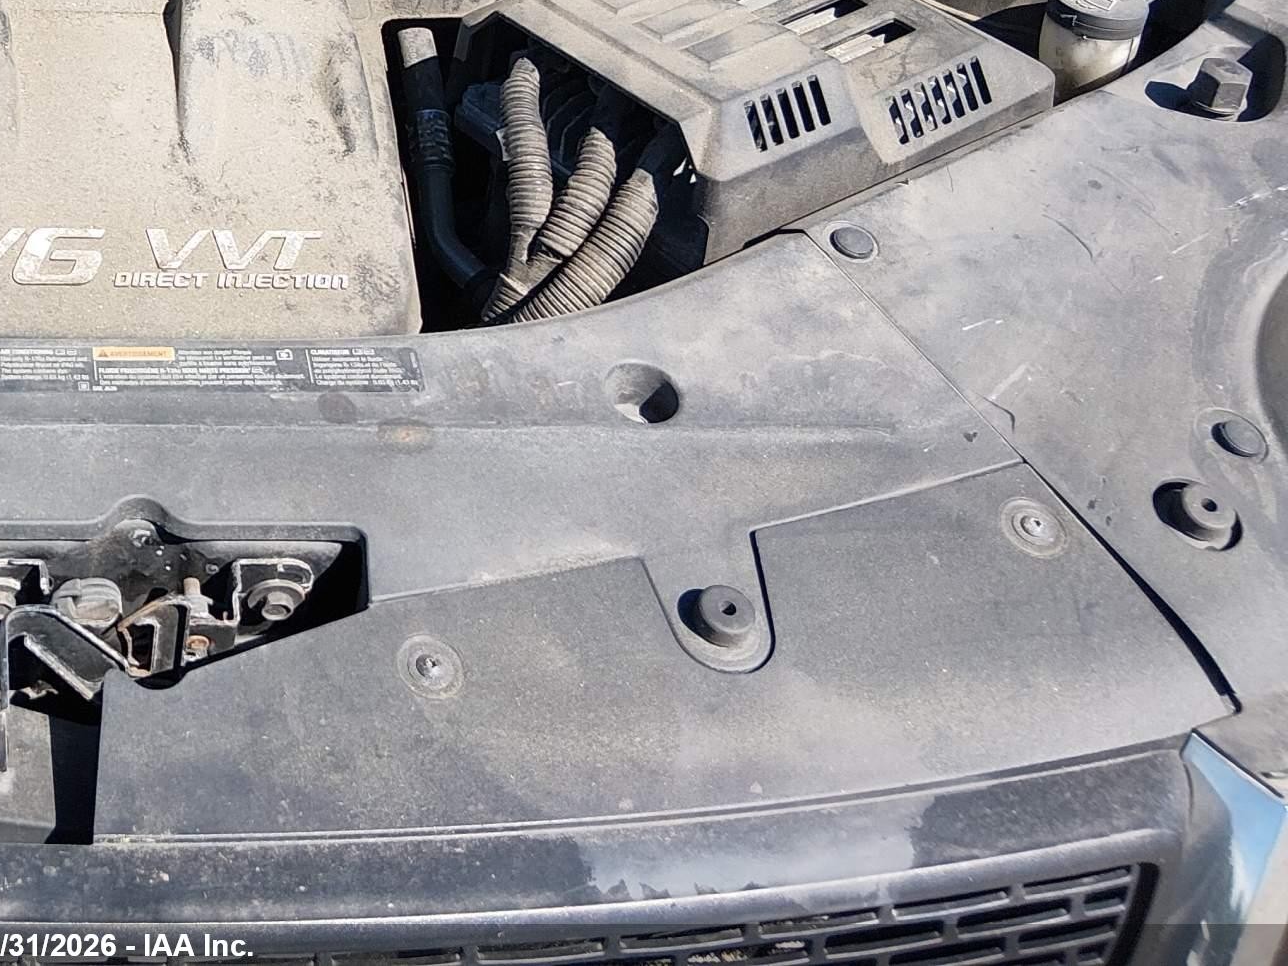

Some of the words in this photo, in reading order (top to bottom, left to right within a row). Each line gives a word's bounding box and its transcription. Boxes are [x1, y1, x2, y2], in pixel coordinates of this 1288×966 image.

[145, 227, 323, 271] VVT
[113, 272, 208, 289] DIRECT
[216, 272, 349, 290] INJECTION
